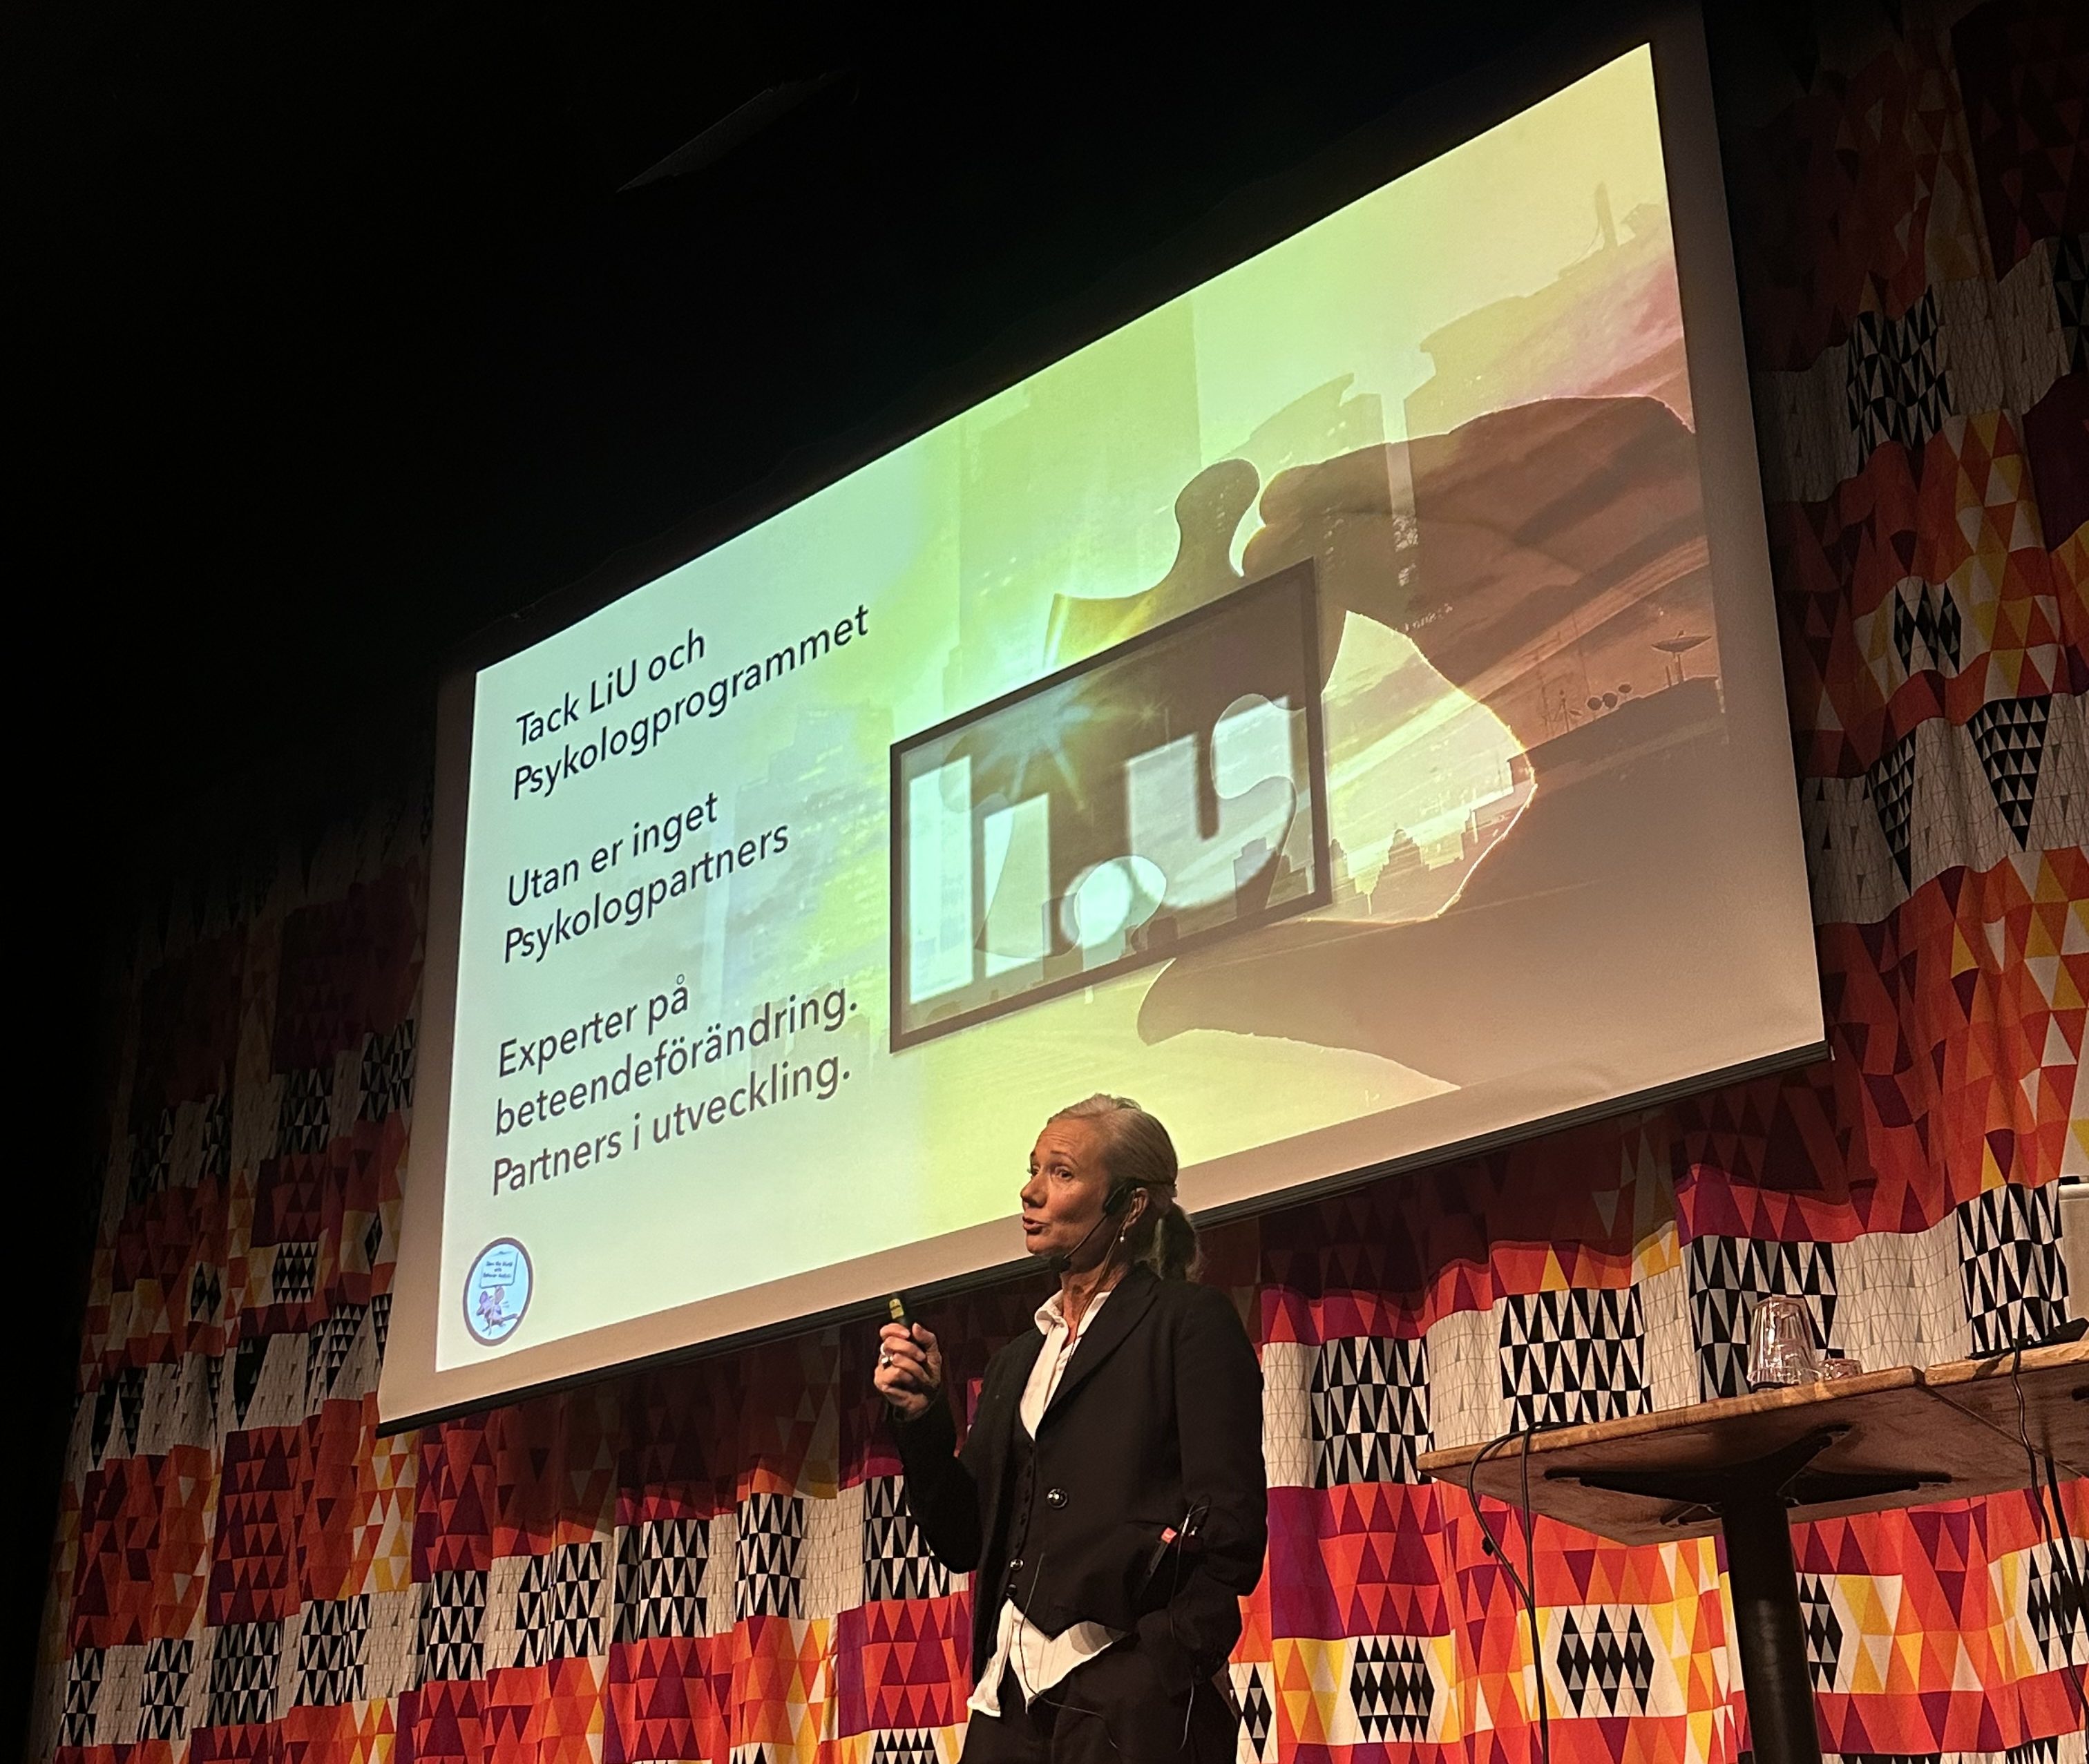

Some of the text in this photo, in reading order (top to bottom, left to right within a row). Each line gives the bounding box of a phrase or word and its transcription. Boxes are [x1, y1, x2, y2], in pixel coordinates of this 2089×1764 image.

[513, 604, 870, 800] Psykologprogrammet
[515, 627, 705, 747] Tack LiU och
[504, 825, 789, 964] Psykologpartners
[508, 792, 718, 907] Utan er inget
[495, 988, 857, 1137] beteendeförändring.
[499, 973, 689, 1078] Experter på
[493, 1056, 850, 1196] Partners i utveckling.
